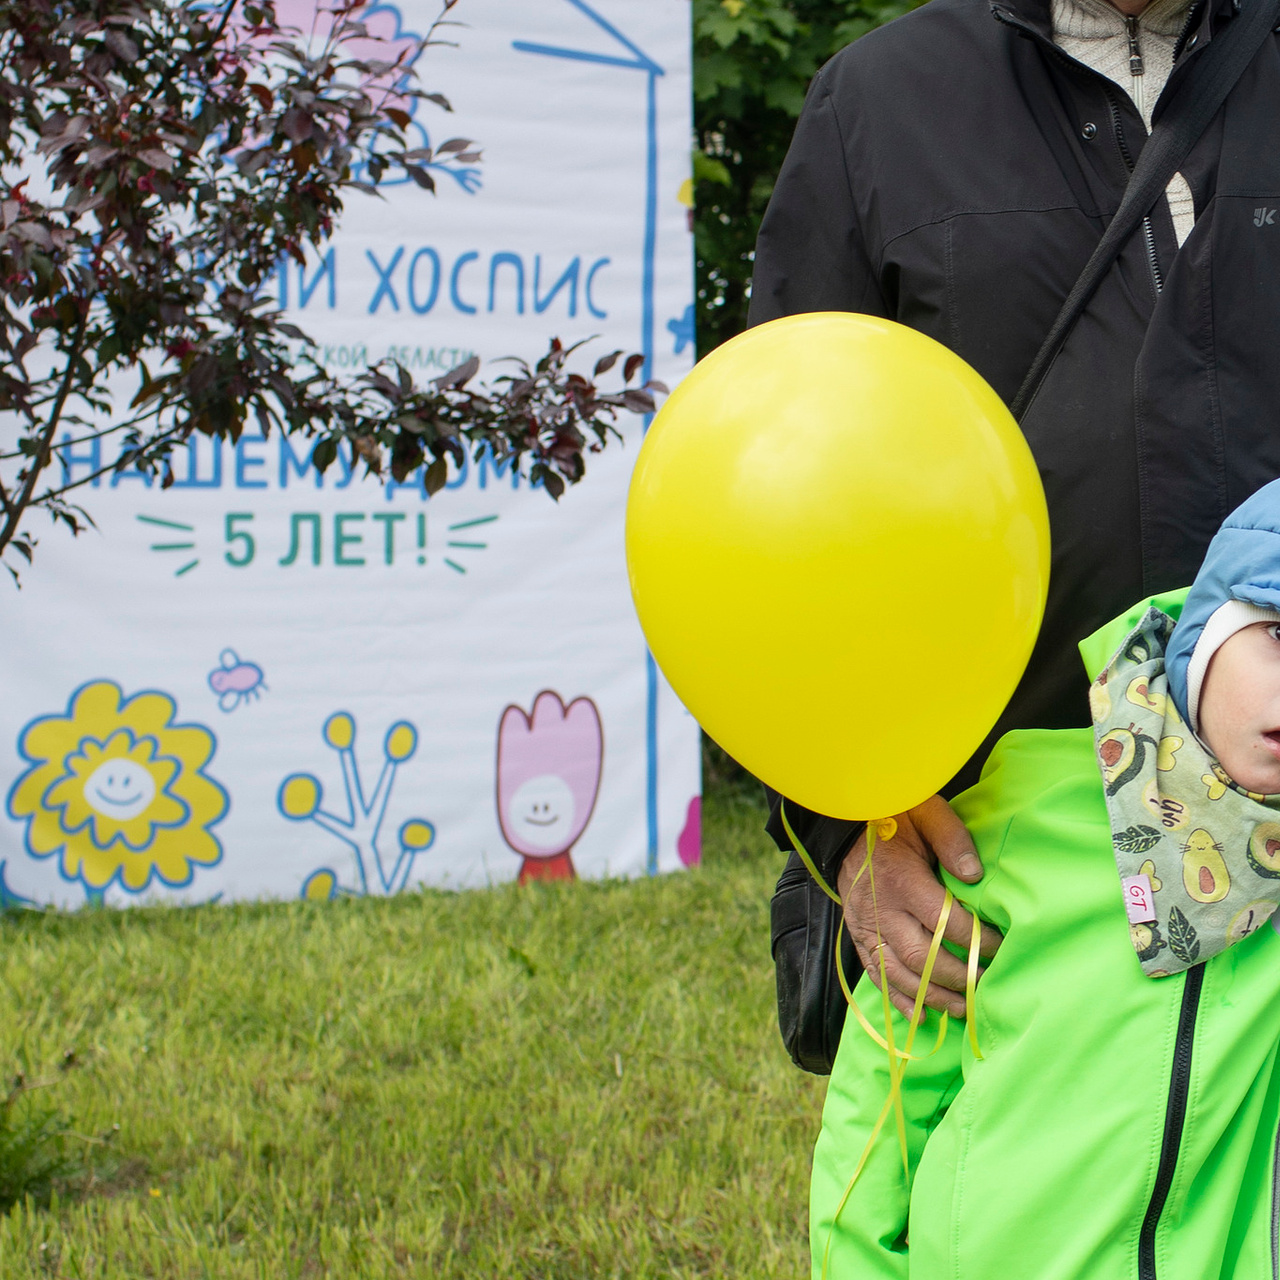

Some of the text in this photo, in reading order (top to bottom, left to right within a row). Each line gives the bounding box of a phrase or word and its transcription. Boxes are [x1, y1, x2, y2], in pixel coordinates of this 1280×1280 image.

[366, 245, 611, 319] ХОСПИС
[224, 511, 427, 567] 5 ЛЕТ!
[1129, 884, 1147, 912] GT
